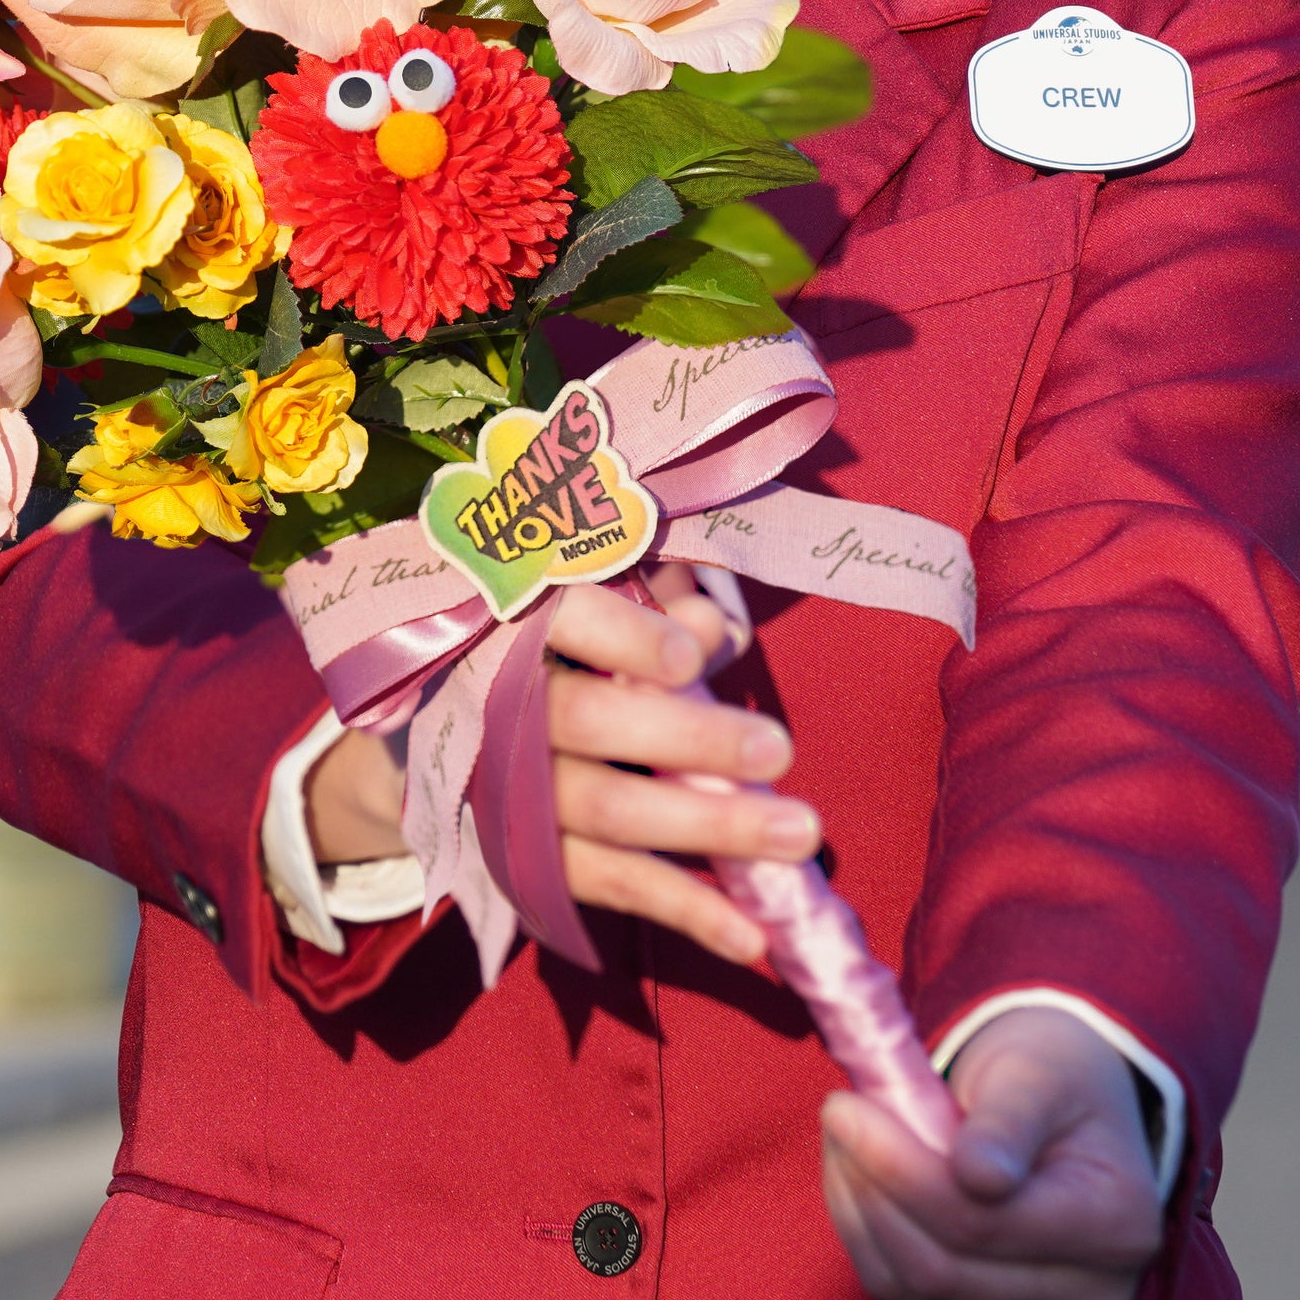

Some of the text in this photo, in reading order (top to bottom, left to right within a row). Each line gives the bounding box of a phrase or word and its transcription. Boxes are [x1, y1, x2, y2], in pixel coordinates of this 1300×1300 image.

[1033, 28, 1121, 40] UNIVERSAL STUDIOS
[1042, 87, 1122, 108] CREW
[456, 390, 600, 551] THANKS
[493, 462, 622, 563] LOVE
[560, 525, 627, 562] MONTH
[811, 527, 955, 580] Special
[574, 1203, 637, 1275] UNIVERSAL STUDIOS JAPAN
